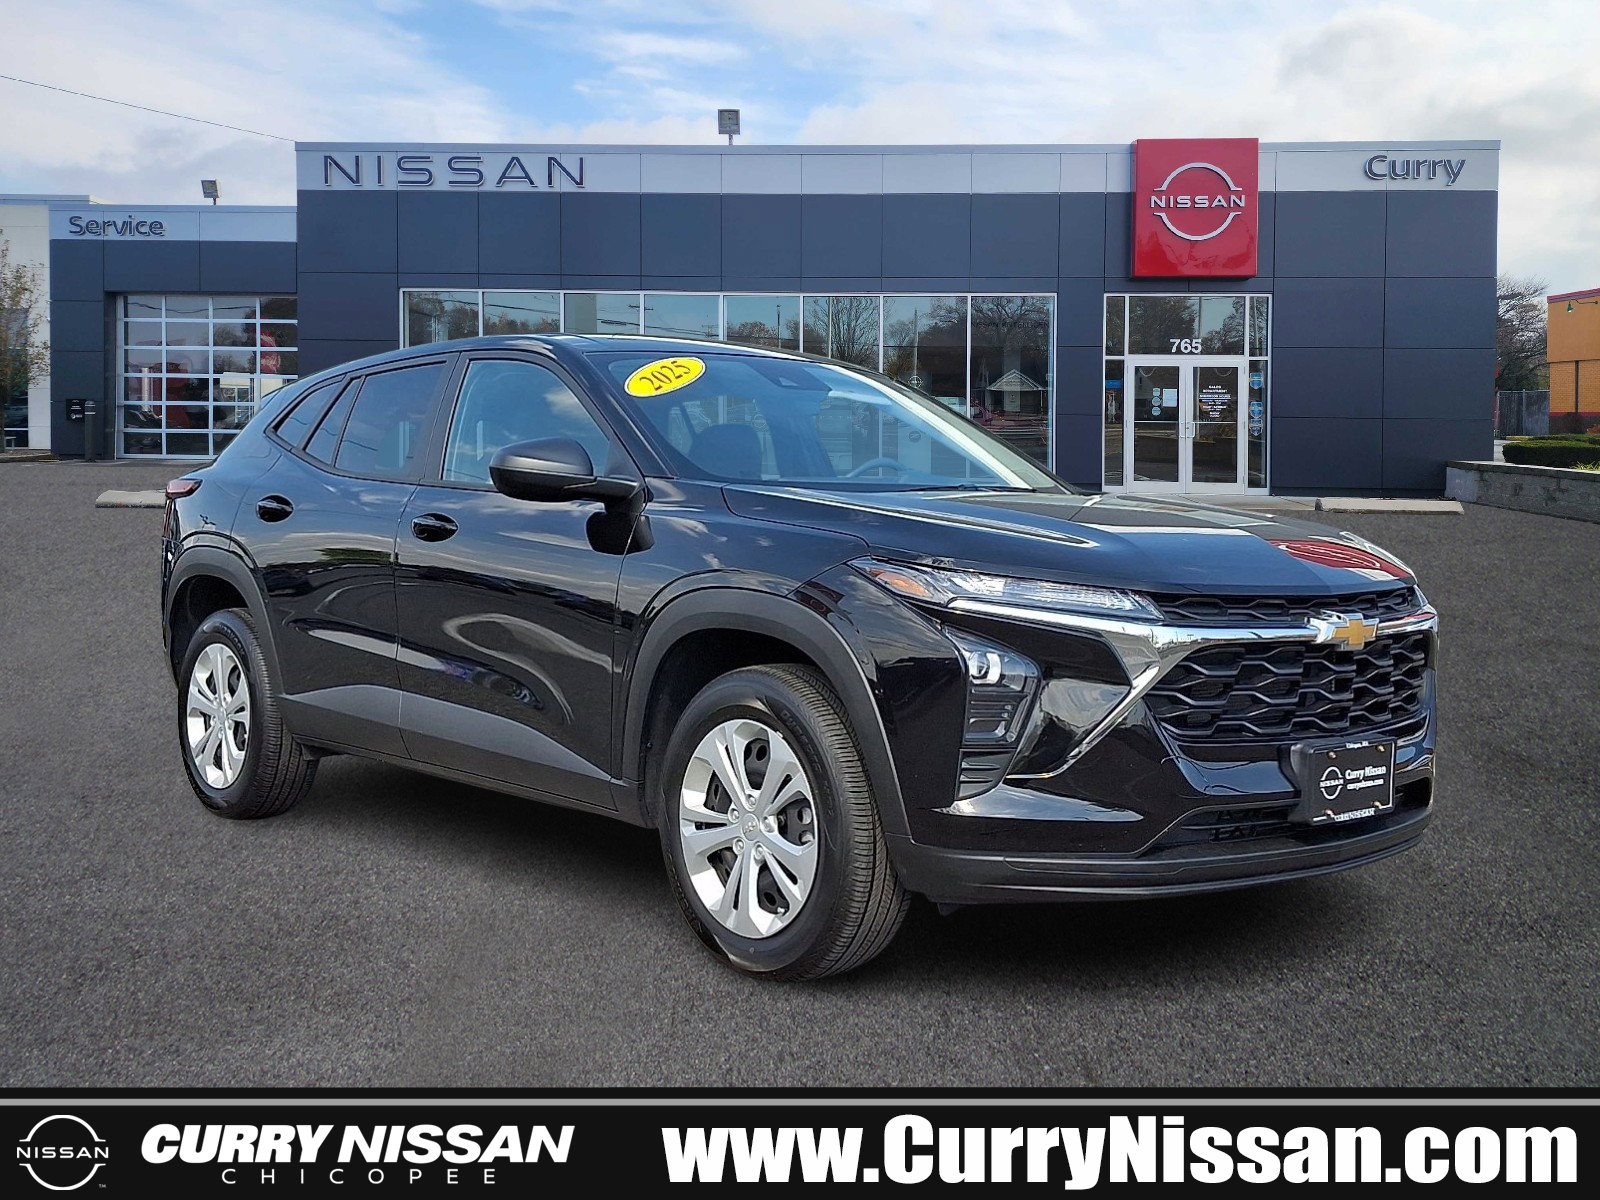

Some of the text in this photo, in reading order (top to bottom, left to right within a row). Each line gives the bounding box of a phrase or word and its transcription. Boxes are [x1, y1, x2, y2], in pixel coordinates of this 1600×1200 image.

[324, 155, 585, 188] NISSAN
[1364, 155, 1466, 186] Curry
[1150, 194, 1245, 209] NISSAN
[69, 215, 165, 236] Service
[1170, 338, 1202, 353] 765
[639, 360, 691, 391] 2025
[1345, 766, 1386, 780] Curry Nissan
[1320, 779, 1344, 787] NISSAN
